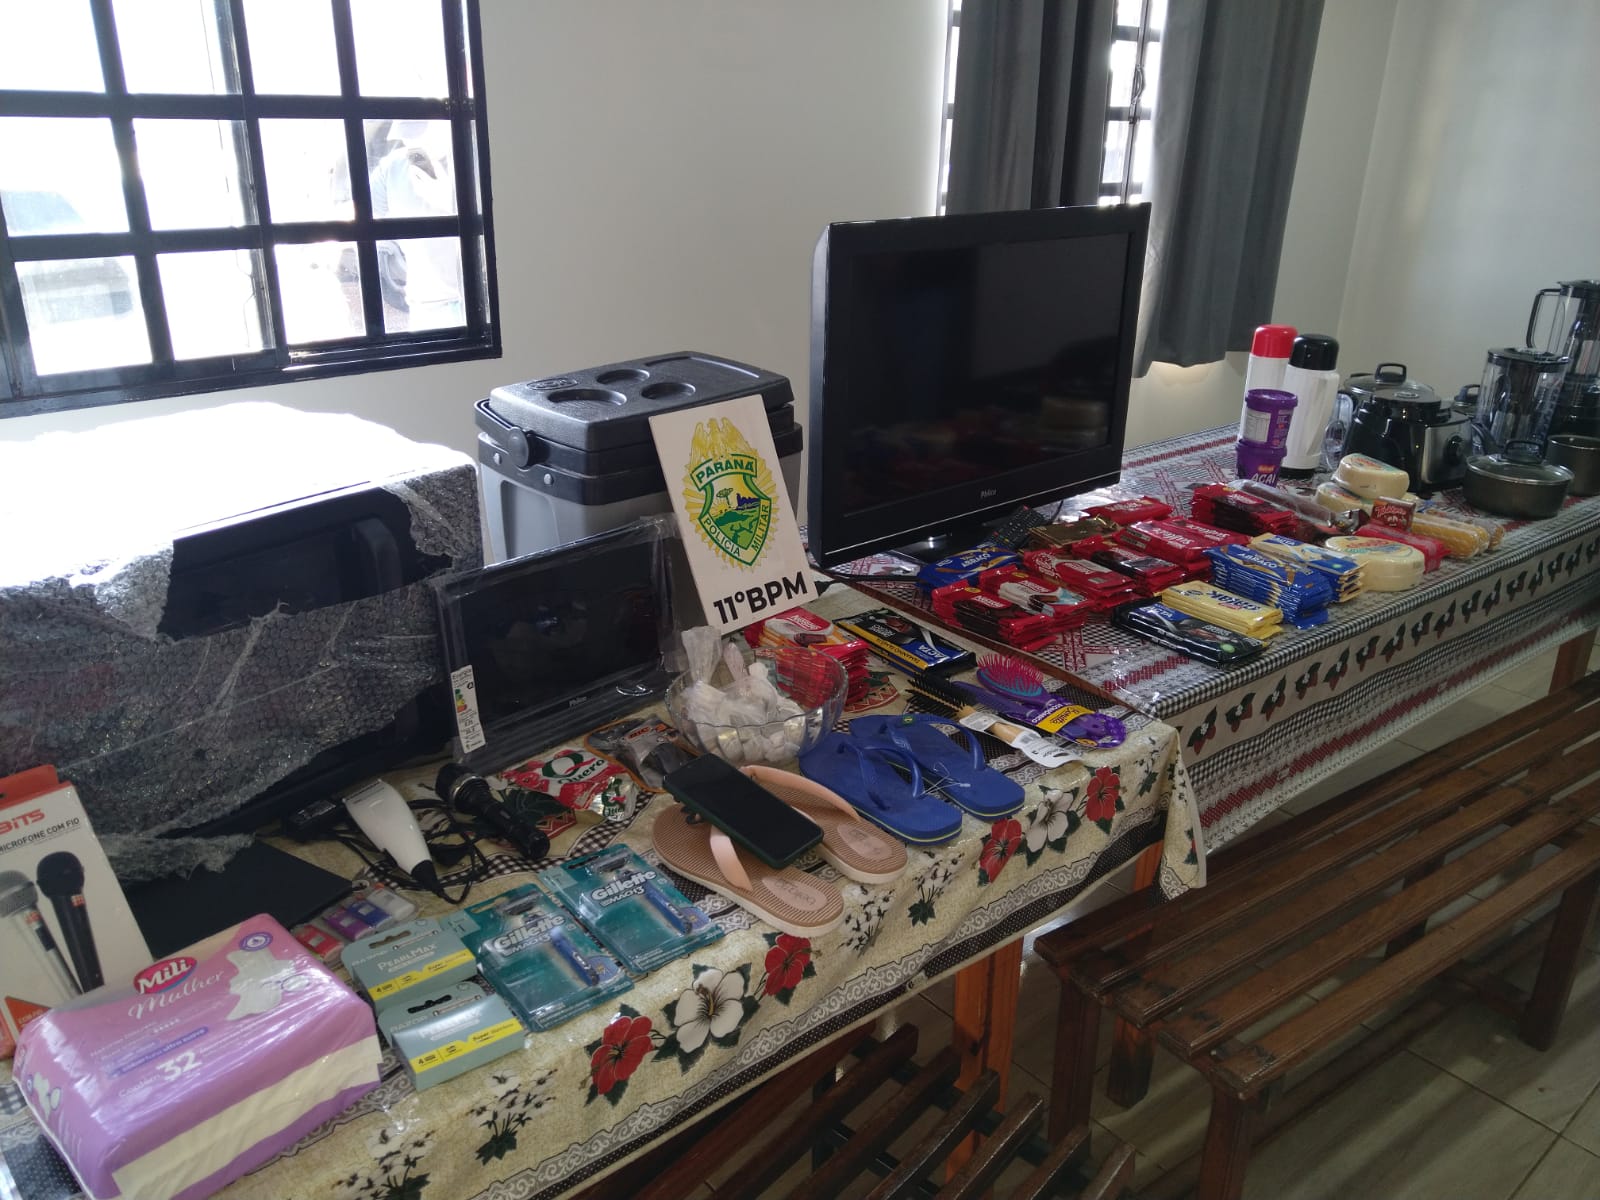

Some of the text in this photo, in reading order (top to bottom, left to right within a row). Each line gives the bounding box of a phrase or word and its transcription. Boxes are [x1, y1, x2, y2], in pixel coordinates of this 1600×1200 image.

[751, 504, 769, 551] MILITAR
[557, 759, 605, 786] Quero
[46, 823, 65, 835] COM
[65, 817, 80, 828] FIO
[592, 871, 657, 901] Gillette
[493, 915, 565, 950] Gillette
[138, 958, 192, 994] Mili
[128, 970, 225, 1020] Mulher
[156, 1050, 203, 1082] 32
